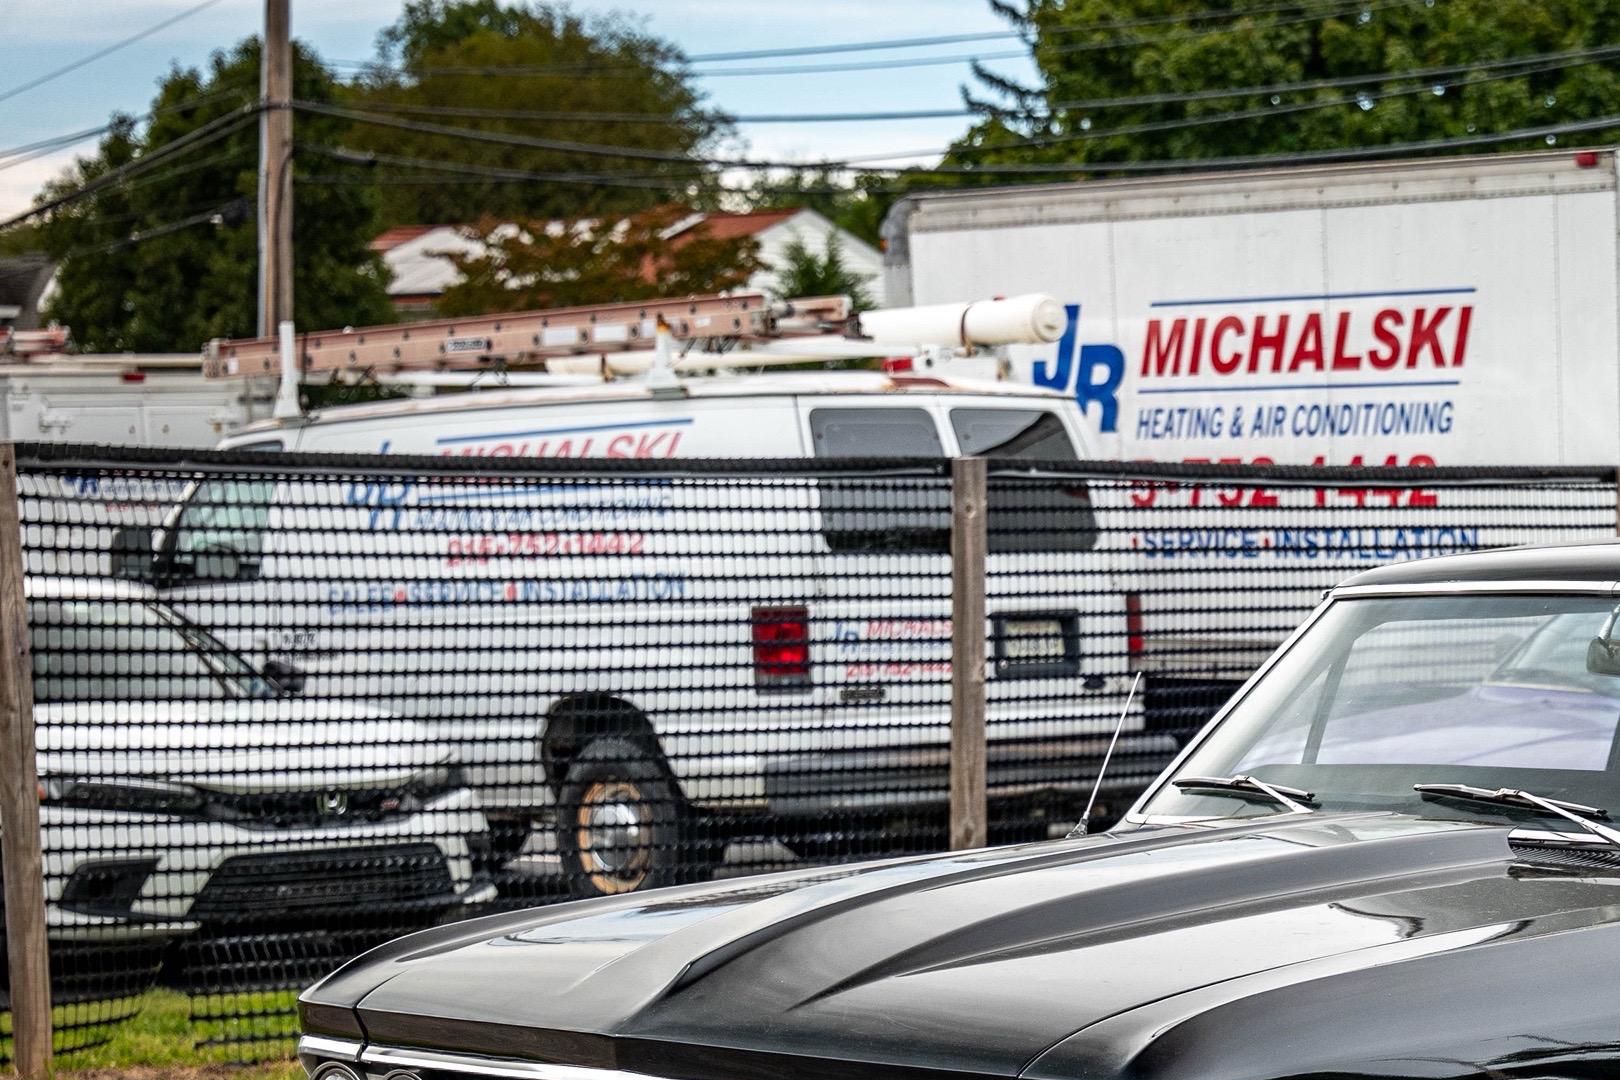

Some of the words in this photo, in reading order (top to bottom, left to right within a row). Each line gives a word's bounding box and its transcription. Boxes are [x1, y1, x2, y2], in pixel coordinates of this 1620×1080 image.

[1141, 306, 1473, 377] MICHALSKI
[1136, 406, 1223, 440] HEATING
[1230, 406, 1243, 436] &
[1250, 404, 1286, 437] AIR
[1293, 401, 1455, 436] CONDITIONING
[1144, 528, 1258, 558] SERVICE
[1275, 527, 1479, 559] INSTALLATION
